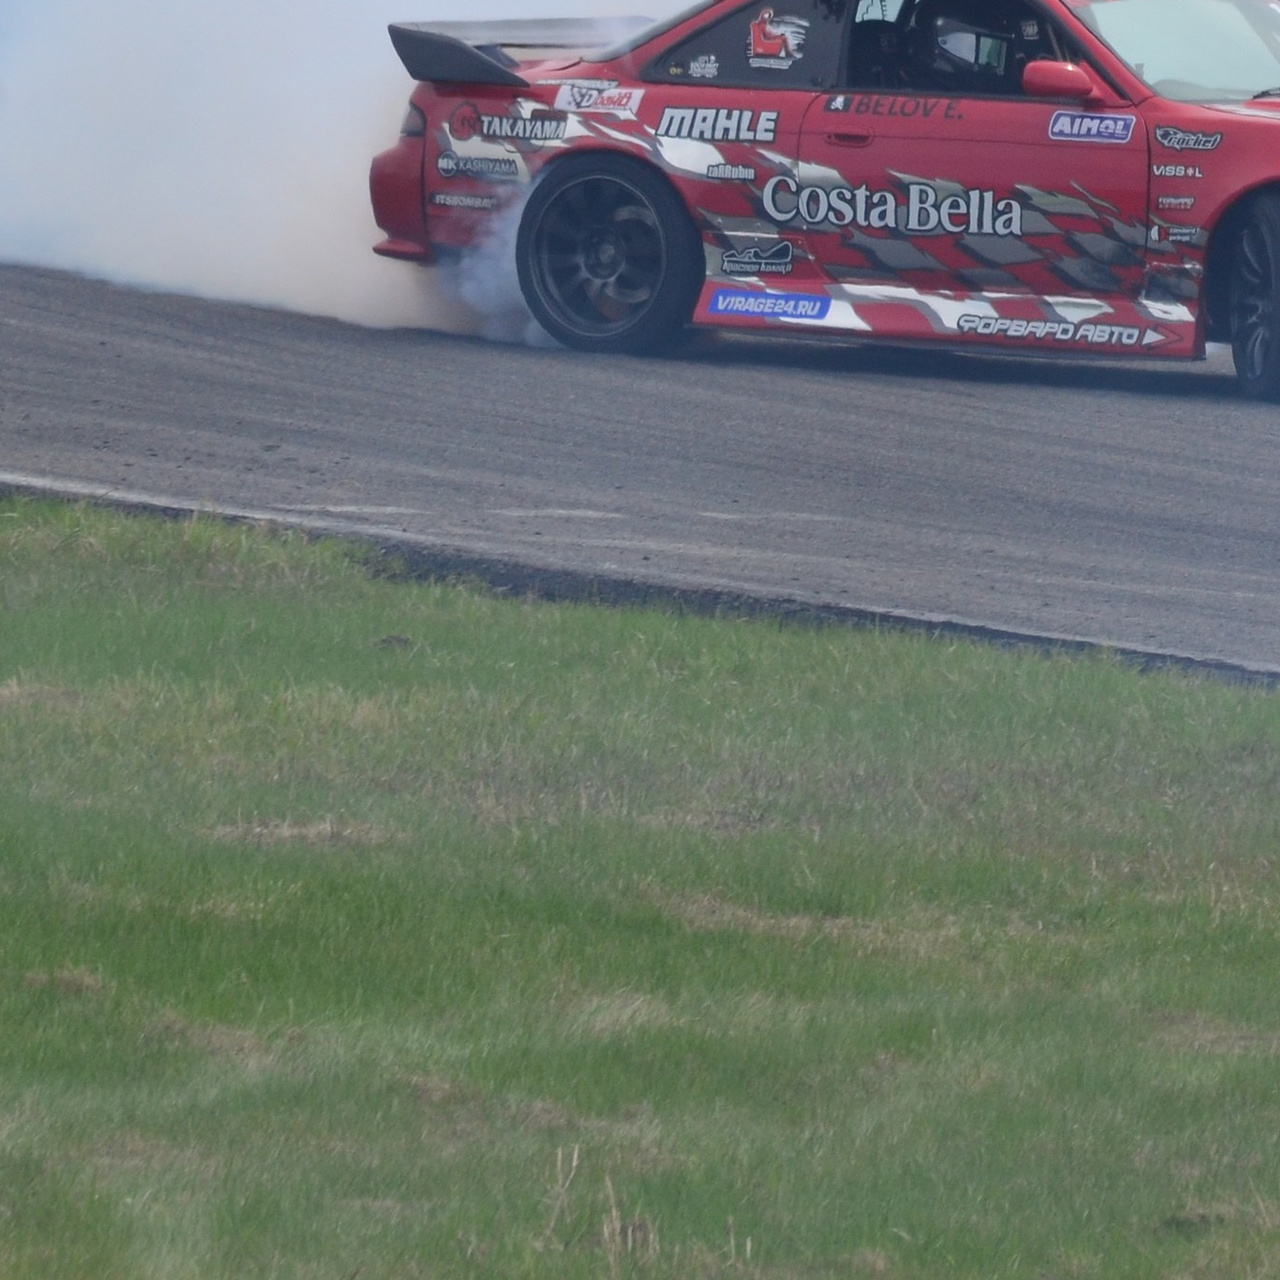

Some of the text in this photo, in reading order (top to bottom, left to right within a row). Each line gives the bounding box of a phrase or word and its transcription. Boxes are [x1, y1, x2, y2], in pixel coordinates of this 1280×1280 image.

[855, 95, 939, 116] BELOV
[481, 116, 566, 139] TAKAYAMA
[656, 107, 778, 141] MAHLE
[1053, 115, 1128, 137] AIMOL
[458, 157, 518, 173] KASHIYAMA
[763, 176, 1022, 236] Costa Bella
[717, 296, 821, 316] VIRAGE24.RU
[959, 315, 1139, 344] ФОРВАРД АВТО
